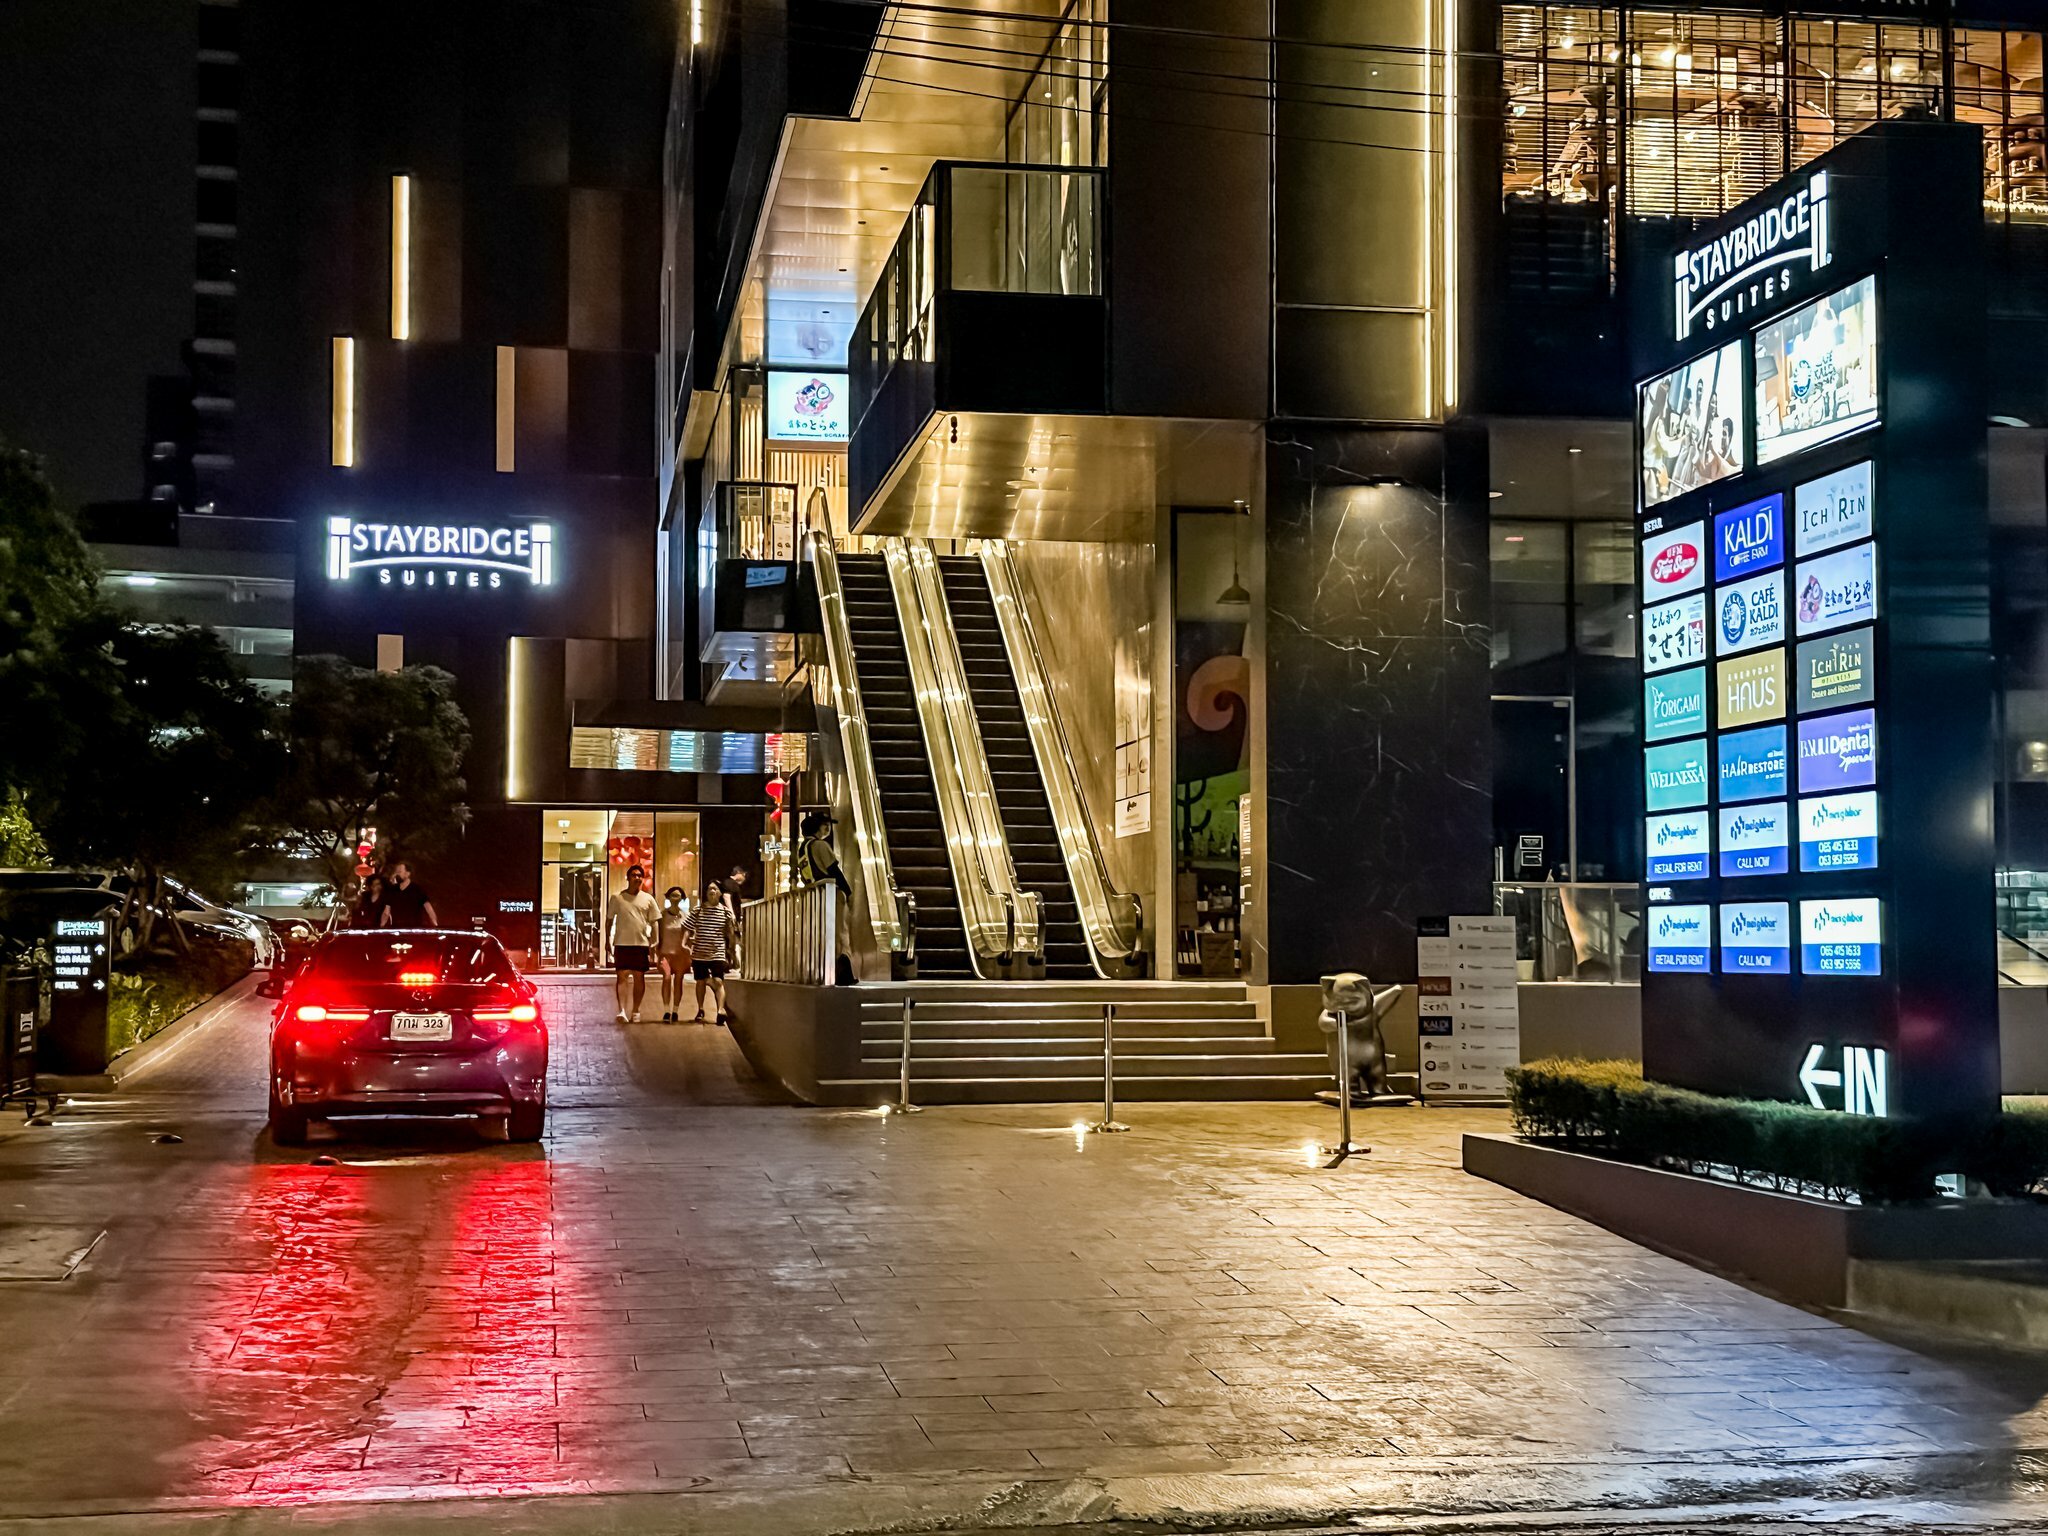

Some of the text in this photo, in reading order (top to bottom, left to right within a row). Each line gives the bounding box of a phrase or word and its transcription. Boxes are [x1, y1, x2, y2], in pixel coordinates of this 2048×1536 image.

[1689, 188, 1809, 293] STAYBRIDGE
[1706, 268, 1791, 330] SUITES
[352, 523, 530, 557] STAYBRIDGE
[1725, 506, 1773, 555] KALDI
[379, 568, 501, 588] SUITES
[1751, 582, 1775, 606] CAFÉ
[1749, 602, 1778, 624] KALDI
[1727, 676, 1776, 714] HAUS
[1736, 856, 1770, 869] CALL NOW
[1738, 954, 1772, 966] CALL NOW
[423, 1018, 444, 1028] 323
[1843, 1046, 1887, 1119] IN
